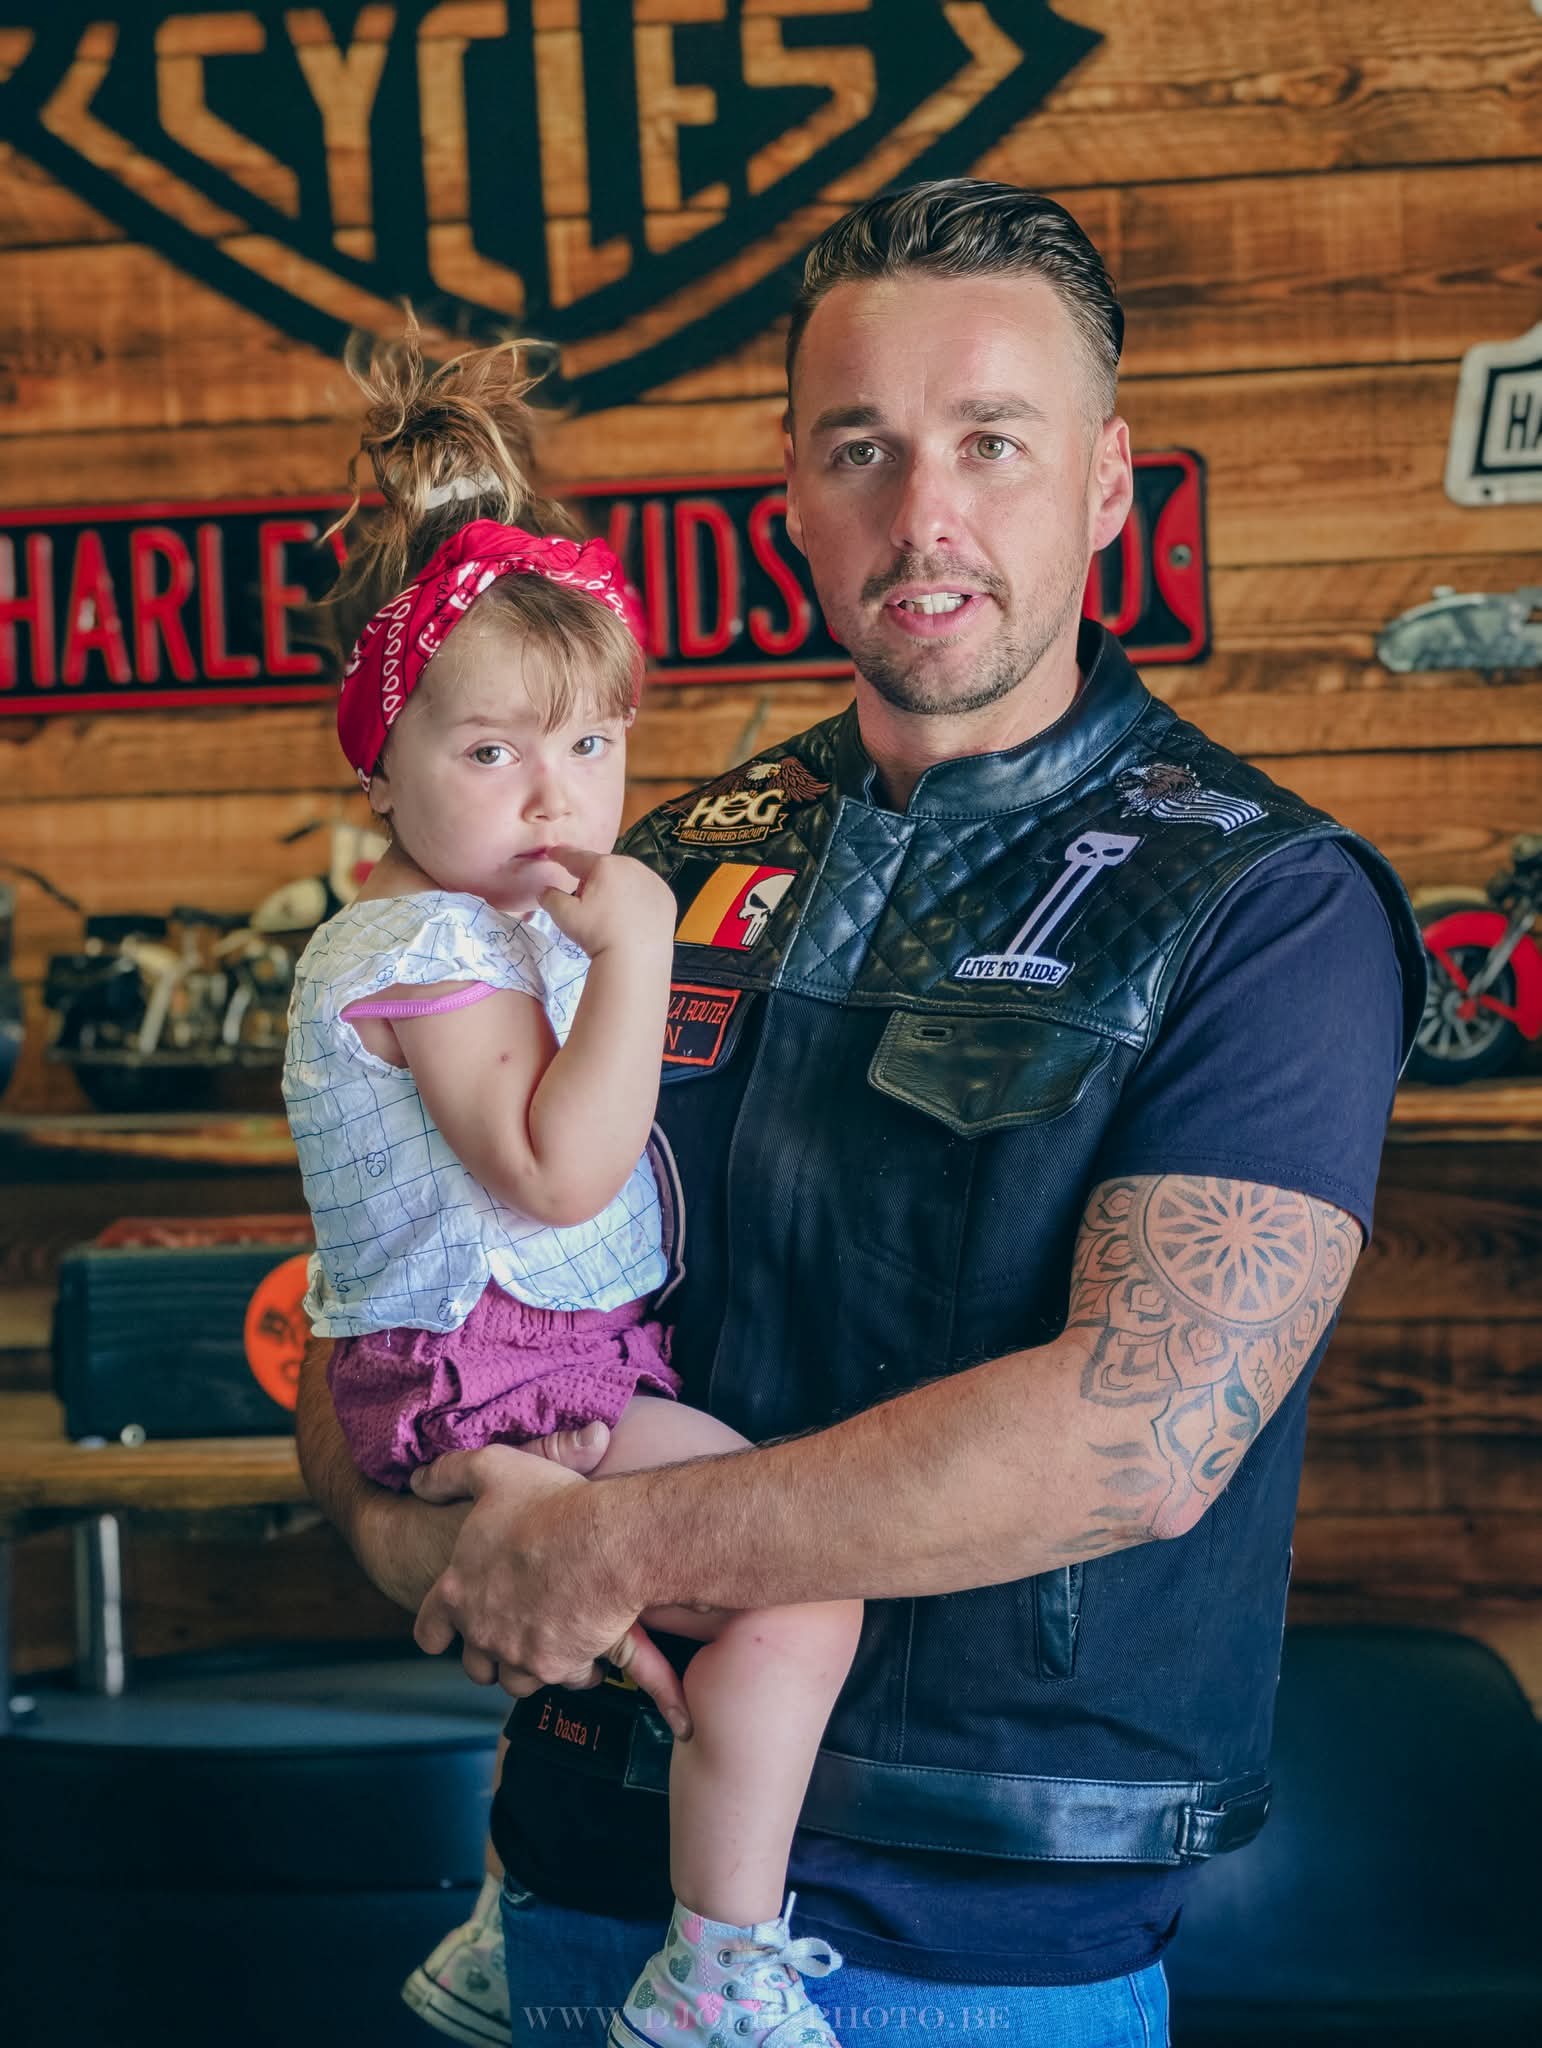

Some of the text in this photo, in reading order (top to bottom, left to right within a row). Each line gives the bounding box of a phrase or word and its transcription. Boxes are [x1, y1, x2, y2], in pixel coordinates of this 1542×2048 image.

[155, 0, 878, 316] CYCLES
[0, 523, 347, 688] HARLE
[737, 826, 765, 841] GROUP
[959, 960, 1061, 982] LIVE TO RIDE
[683, 1000, 728, 1024] ROUTE
[555, 1709, 588, 1745] basta
